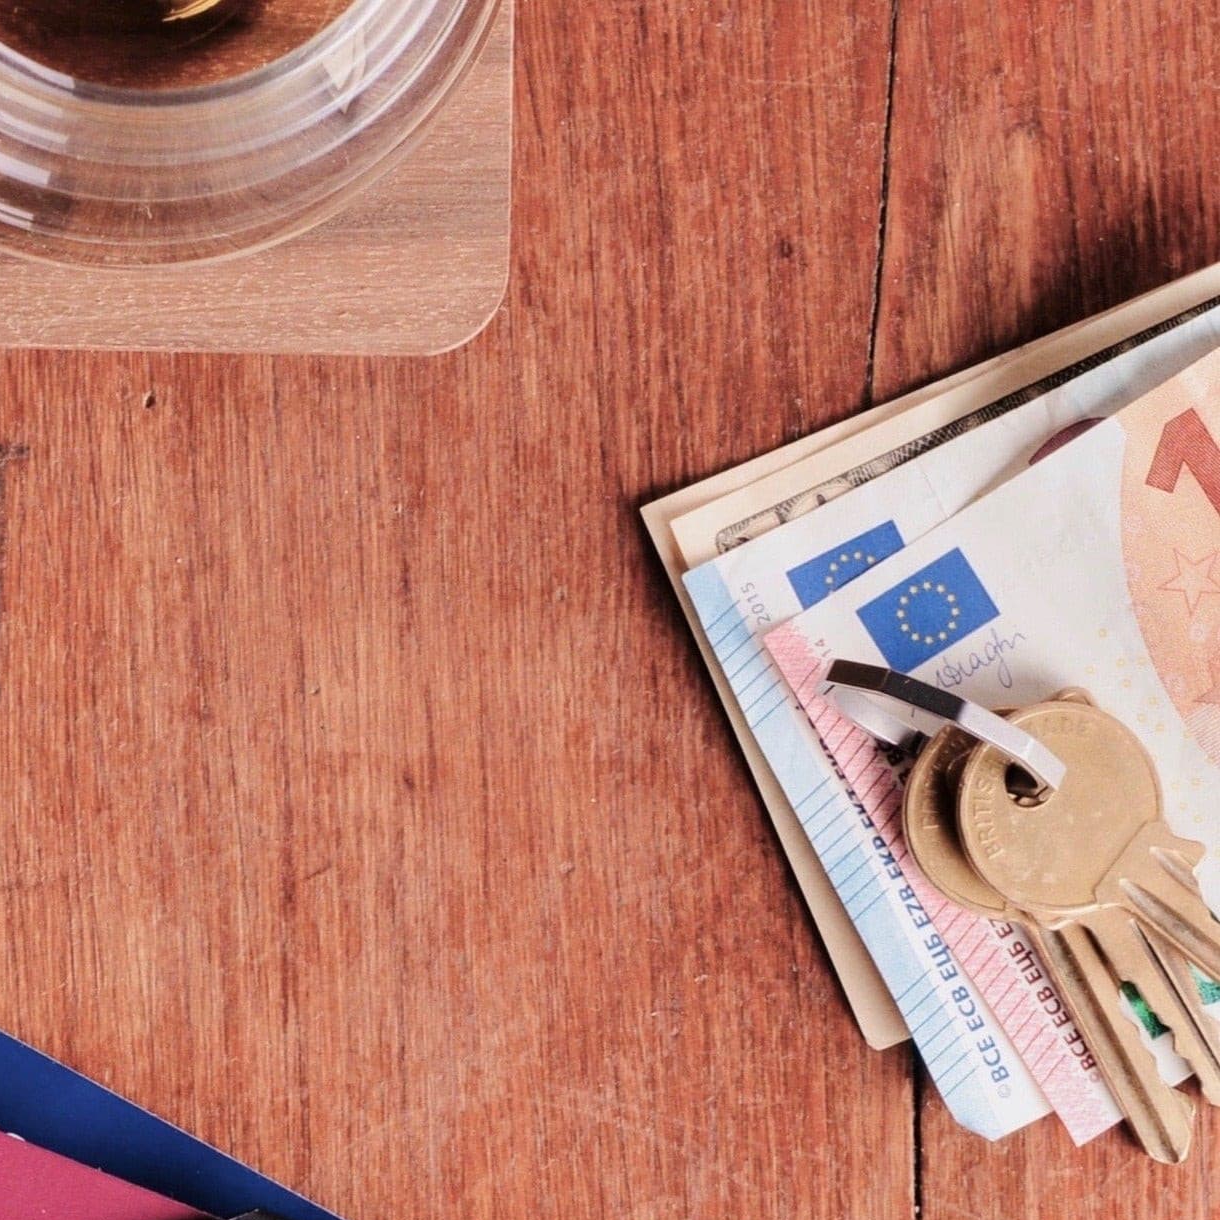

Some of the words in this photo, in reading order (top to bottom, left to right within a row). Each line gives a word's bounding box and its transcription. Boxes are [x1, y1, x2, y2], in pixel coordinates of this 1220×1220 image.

[740, 582, 772, 625] 2015
[898, 883, 930, 930] EZB
[951, 984, 986, 1033] ECB
[1035, 985, 1071, 1029] ECB
[976, 1034, 1010, 1084] BCE
[1063, 1027, 1098, 1071] BCE
